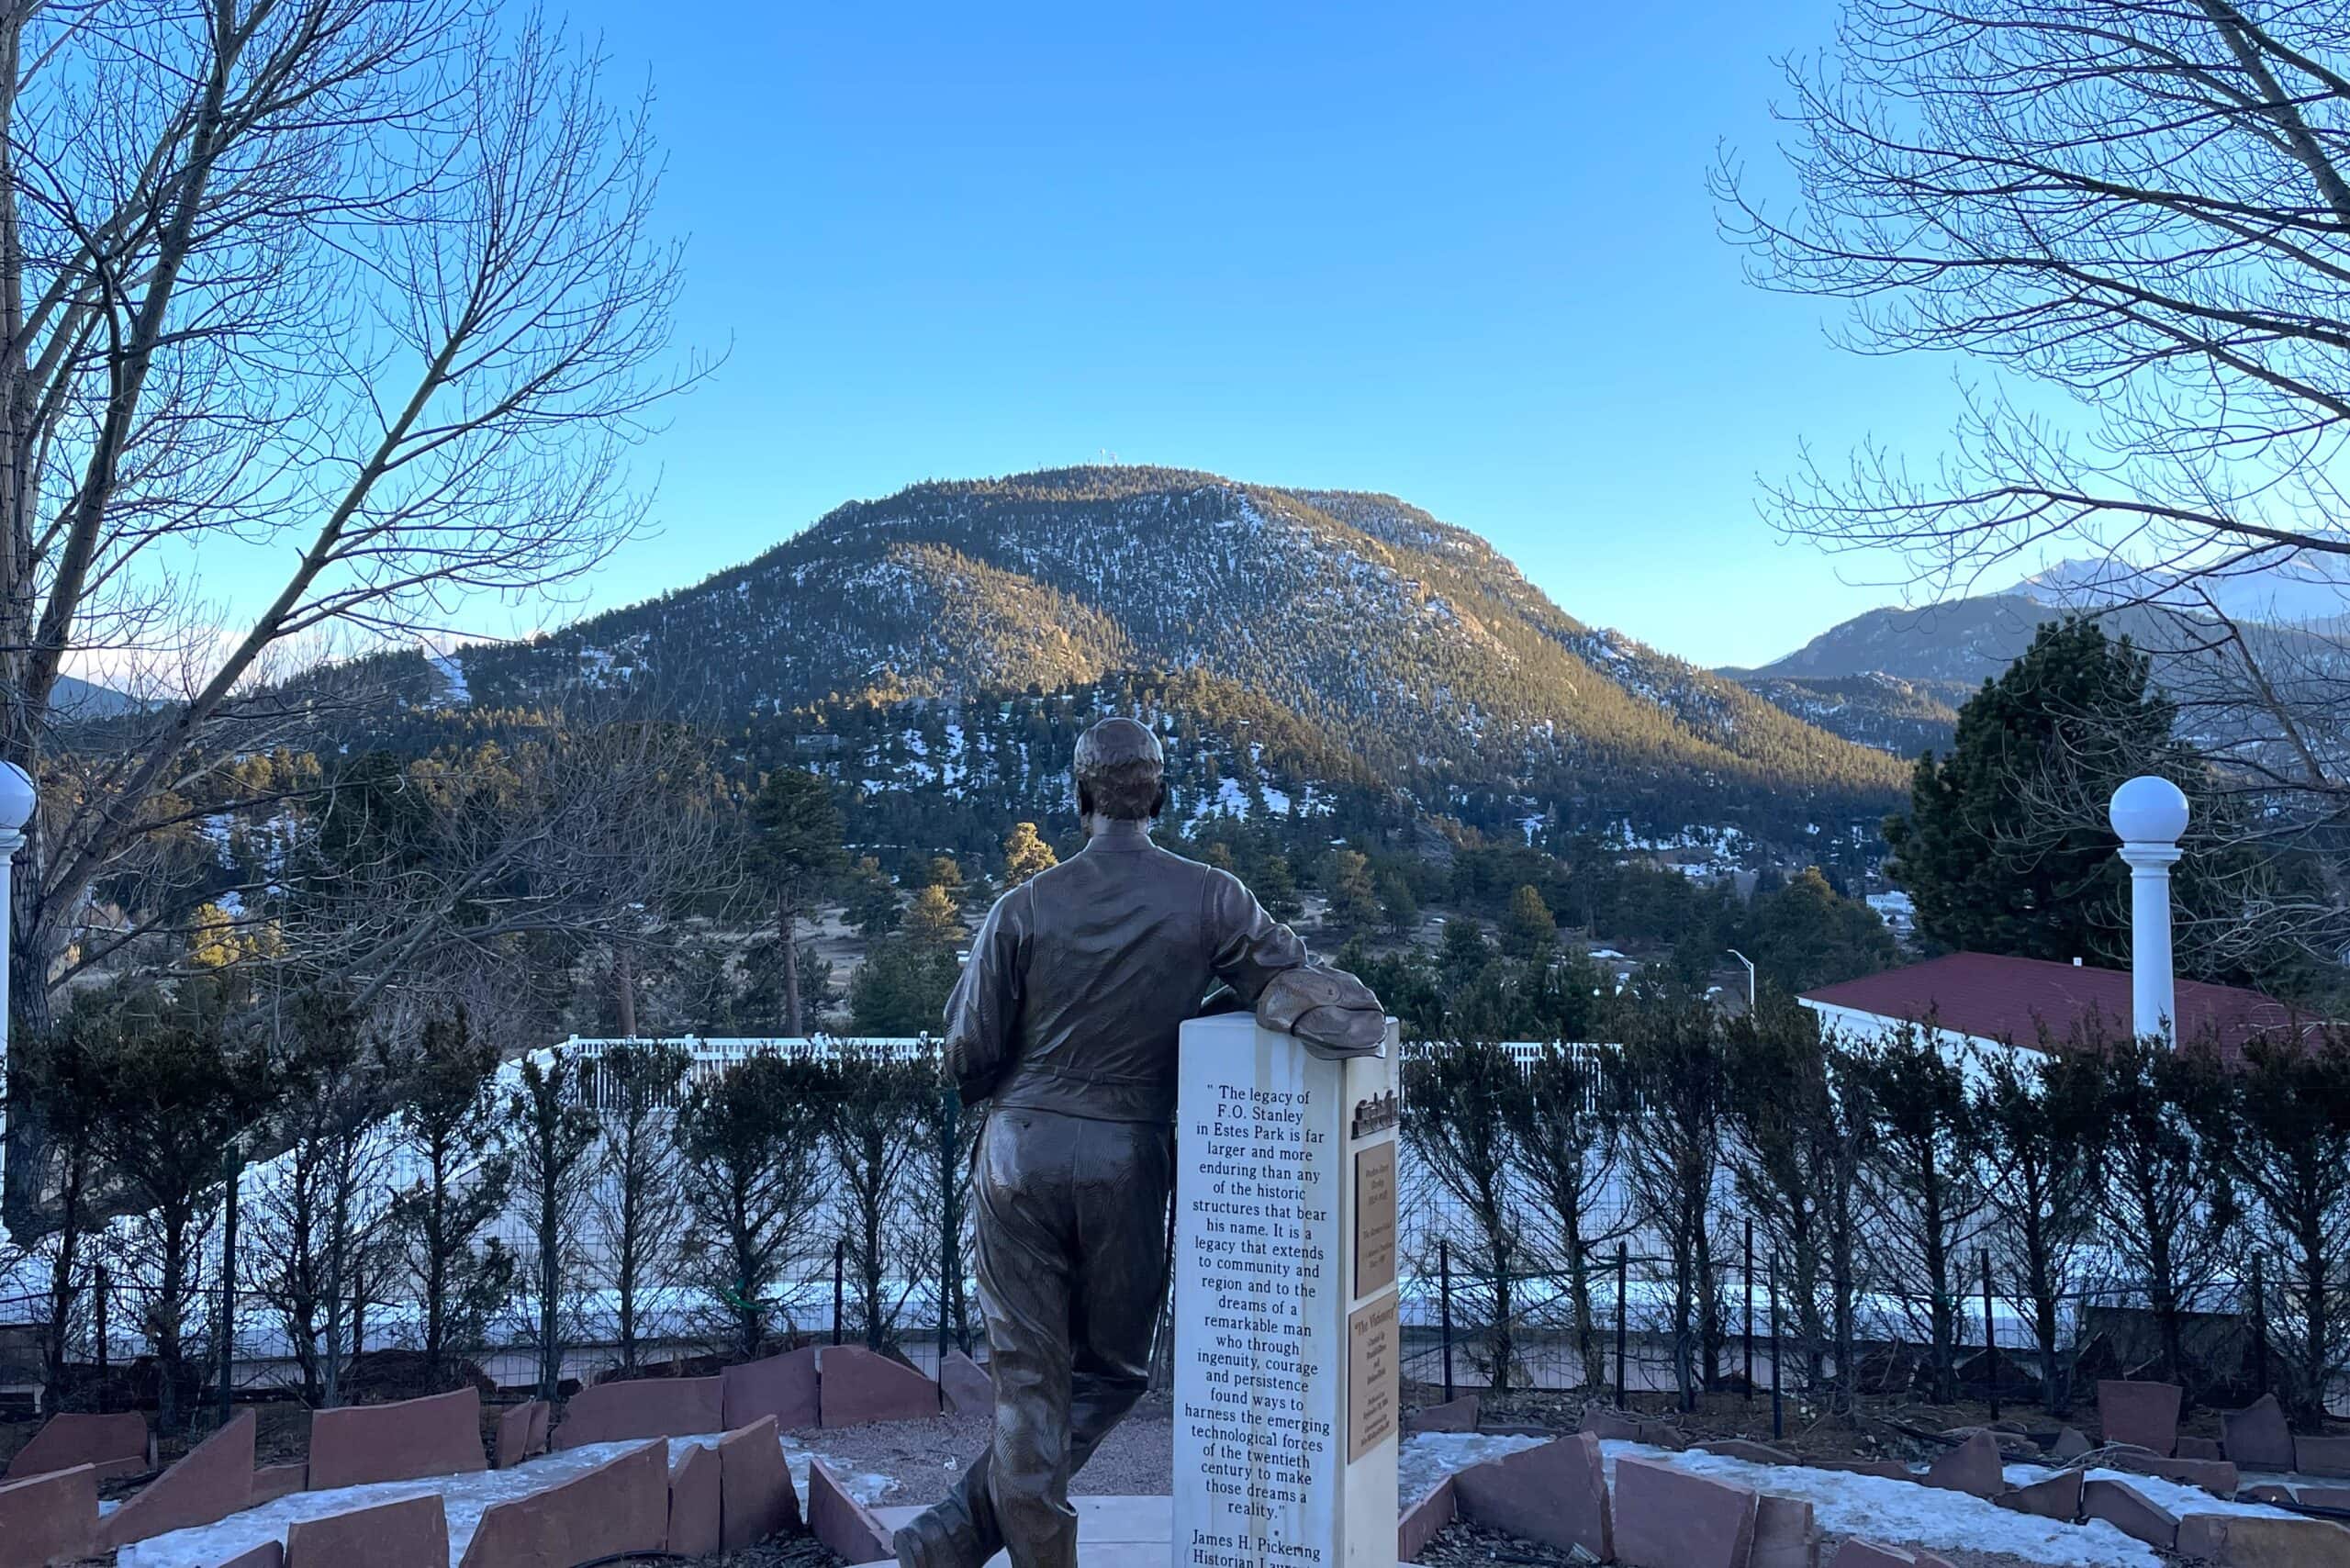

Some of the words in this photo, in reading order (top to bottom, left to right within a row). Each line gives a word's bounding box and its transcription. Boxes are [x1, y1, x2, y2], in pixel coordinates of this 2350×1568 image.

[1219, 1085, 1246, 1100] The
[1250, 1088, 1292, 1105] legacy
[1297, 1092, 1310, 1103] of
[1218, 1104, 1247, 1119] F.O.
[1253, 1106, 1303, 1125] Stanley
[1197, 1121, 1207, 1135] in
[1214, 1123, 1248, 1137] Estes
[1255, 1126, 1284, 1140] Park
[1290, 1128, 1300, 1141] is
[1305, 1129, 1325, 1143] far
[1208, 1141, 1246, 1158] larger
[1252, 1146, 1274, 1159] and
[1280, 1149, 1313, 1161] more
[1200, 1161, 1257, 1179] enduring
[1262, 1165, 1291, 1180] than
[1297, 1170, 1320, 1183] any
[1214, 1181, 1225, 1193] of
[1232, 1182, 1251, 1195] the
[1258, 1183, 1305, 1200] historic
[1193, 1201, 1259, 1215] structures
[1265, 1204, 1291, 1218] that
[1297, 1206, 1326, 1221] bear
[1207, 1218, 1225, 1231] his
[1230, 1224, 1268, 1236] name.
[1274, 1224, 1282, 1238] It
[1290, 1225, 1299, 1238] is
[1305, 1230, 1312, 1239] a
[1195, 1236, 1236, 1254] legacy
[1241, 1240, 1267, 1255] that
[1272, 1246, 1324, 1260] extends
[1199, 1256, 1211, 1267] to
[1217, 1258, 1290, 1277] community
[1296, 1265, 1319, 1278] and
[1203, 1276, 1241, 1292] region
[1248, 1280, 1270, 1293] and
[1277, 1283, 1289, 1295] to
[1295, 1283, 1315, 1297] the
[1219, 1295, 1267, 1312] dreams
[1272, 1301, 1285, 1314] of
[1291, 1305, 1297, 1316] a
[1205, 1316, 1278, 1333] remarkable
[1283, 1324, 1312, 1337] man
[1216, 1335, 1242, 1349] who
[1248, 1338, 1299, 1357] through
[1197, 1349, 1259, 1370] ingenuity,
[1266, 1359, 1318, 1376] courage
[1206, 1371, 1228, 1383] and
[1235, 1373, 1308, 1392] persistence
[1212, 1388, 1247, 1404] found
[1253, 1395, 1285, 1410] ways
[1292, 1398, 1304, 1410] to
[1185, 1404, 1236, 1421] harness
[1241, 1410, 1261, 1424] the
[1268, 1417, 1329, 1436] emerging
[1192, 1425, 1277, 1446] technological
[1283, 1434, 1323, 1451] forces
[1203, 1443, 1215, 1456] of
[1222, 1445, 1241, 1460] the
[1248, 1450, 1310, 1469] twentieth
[1202, 1462, 1252, 1480] century
[1259, 1468, 1270, 1480] to
[1277, 1471, 1312, 1484] make
[1206, 1478, 1241, 1495] those
[1247, 1484, 1296, 1502] dreams
[1301, 1493, 1306, 1503] a
[1192, 1529, 1233, 1548] James
[1238, 1535, 1252, 1550] H.
[1258, 1538, 1320, 1562] Pickering
[1193, 1550, 1254, 1568] Historian
